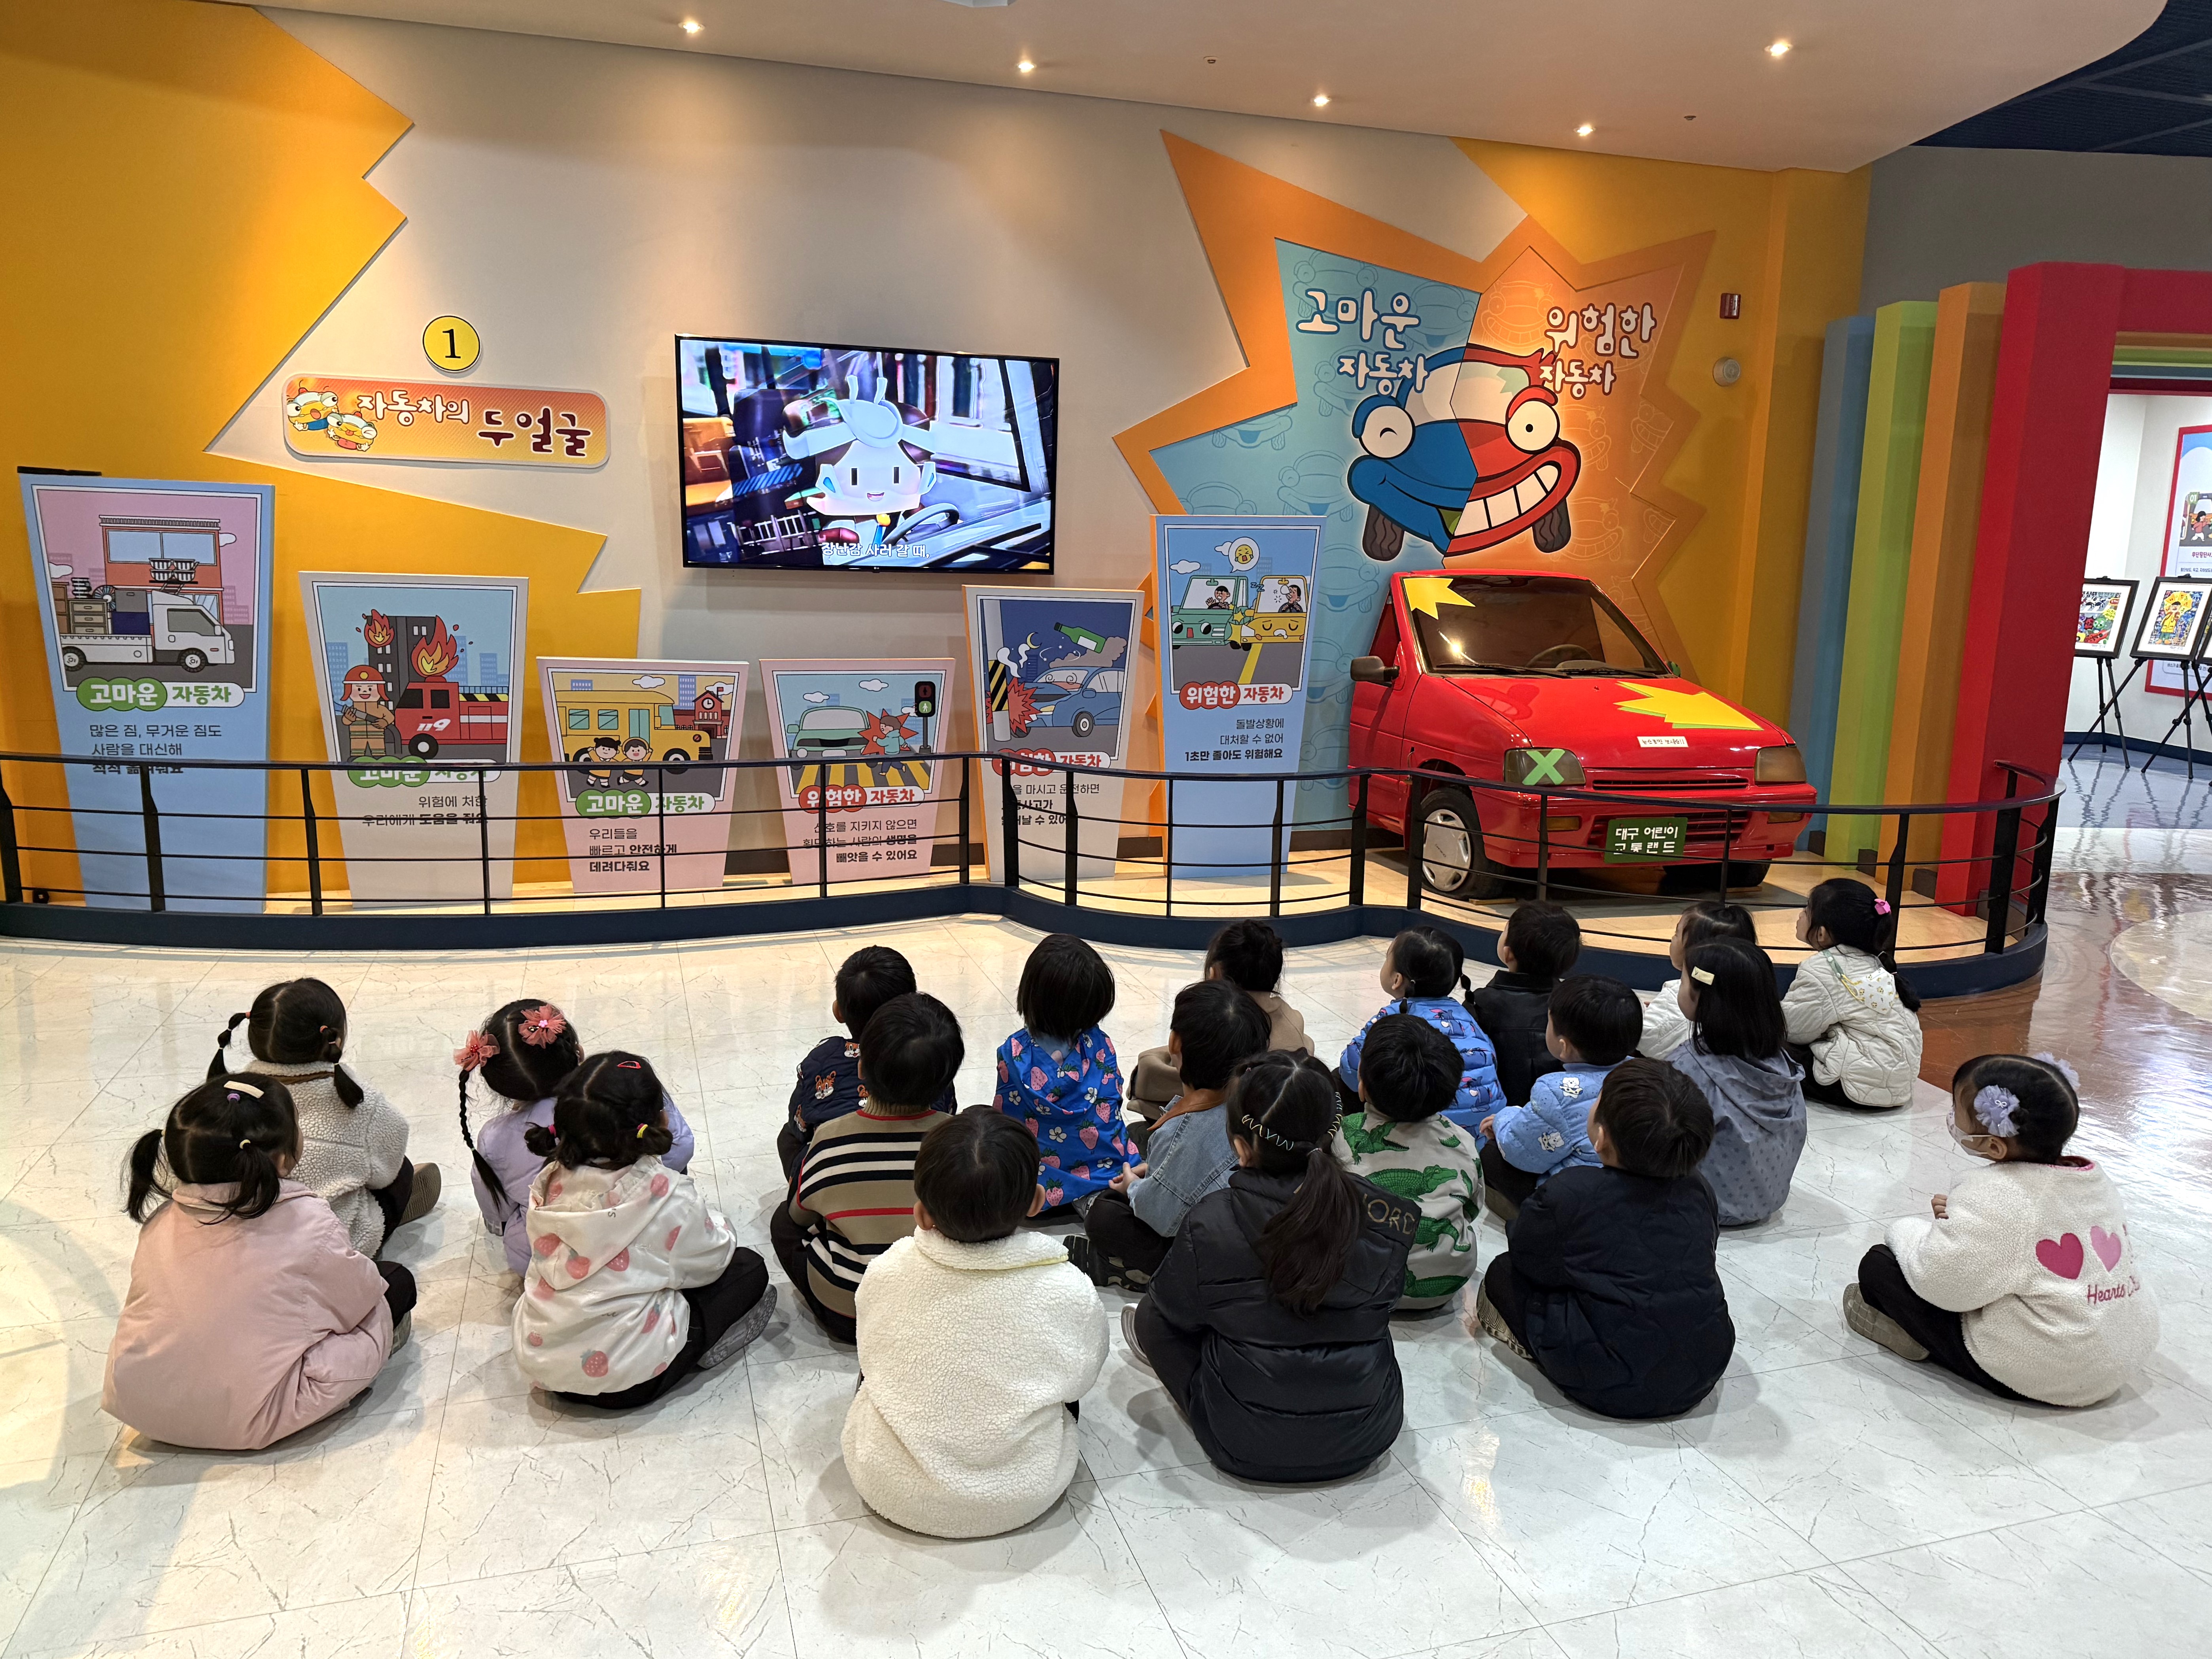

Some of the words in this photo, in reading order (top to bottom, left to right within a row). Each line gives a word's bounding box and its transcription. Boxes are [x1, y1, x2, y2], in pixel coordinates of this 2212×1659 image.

[1296, 287, 1421, 351] 고마운
[1545, 302, 1657, 359] 위험한
[442, 328, 461, 359] 1
[1338, 350, 1430, 396] 자동차
[1539, 358, 1616, 400] 자동차
[357, 389, 470, 426] 자동차의
[821, 542, 862, 556] 장난감
[866, 544, 892, 557] 사러
[896, 544, 909, 557] 갈
[912, 545, 930, 559] 때,
[90, 683, 157, 706] 고마운
[172, 685, 231, 705] 자동차
[1187, 685, 1236, 705] 위험한
[1244, 686, 1284, 703] 자동차
[416, 718, 451, 731] 119
[1236, 718, 1284, 729] 돌발상황에
[90, 724, 118, 737] 많은
[124, 725, 142, 738] 짐,
[146, 725, 189, 737] 무거운
[194, 725, 222, 737] 짐도
[1220, 735, 1250, 745] 대처할
[1252, 734, 1262, 744] 수
[1265, 733, 1283, 743] 없어
[92, 744, 134, 756] 사람을
[140, 743, 182, 756] 대신해
[1185, 750, 1210, 761] 1초만
[1212, 750, 1242, 760] 졸아도
[1245, 748, 1282, 759] 위험해요
[1060, 754, 1101, 768] 자동차
[1026, 784, 1056, 794] 마시고
[418, 796, 457, 807] 위험에
[870, 788, 915, 804] 자동차
[586, 794, 643, 814] 고마운
[655, 795, 704, 812] 자동차
[362, 814, 414, 826] 우리에게
[419, 813, 458, 825] 도움을
[850, 820, 882, 831] 지키지
[885, 819, 917, 830] 않으면
[1034, 815, 1045, 825] 수
[1048, 815, 1067, 825] 있어
[589, 828, 637, 839] 우리들을
[1616, 828, 1639, 840] 대구
[1644, 826, 1678, 839] 어린이
[850, 836, 882, 847] 사람의
[590, 845, 626, 856] 빠르고
[630, 844, 677, 854] 안전하게
[836, 852, 868, 863] 빼앗을
[872, 851, 883, 861] 수
[886, 850, 917, 861] 있어요
[589, 860, 650, 872] 데려다줘요
[2087, 1284, 2125, 1305] Hearts
